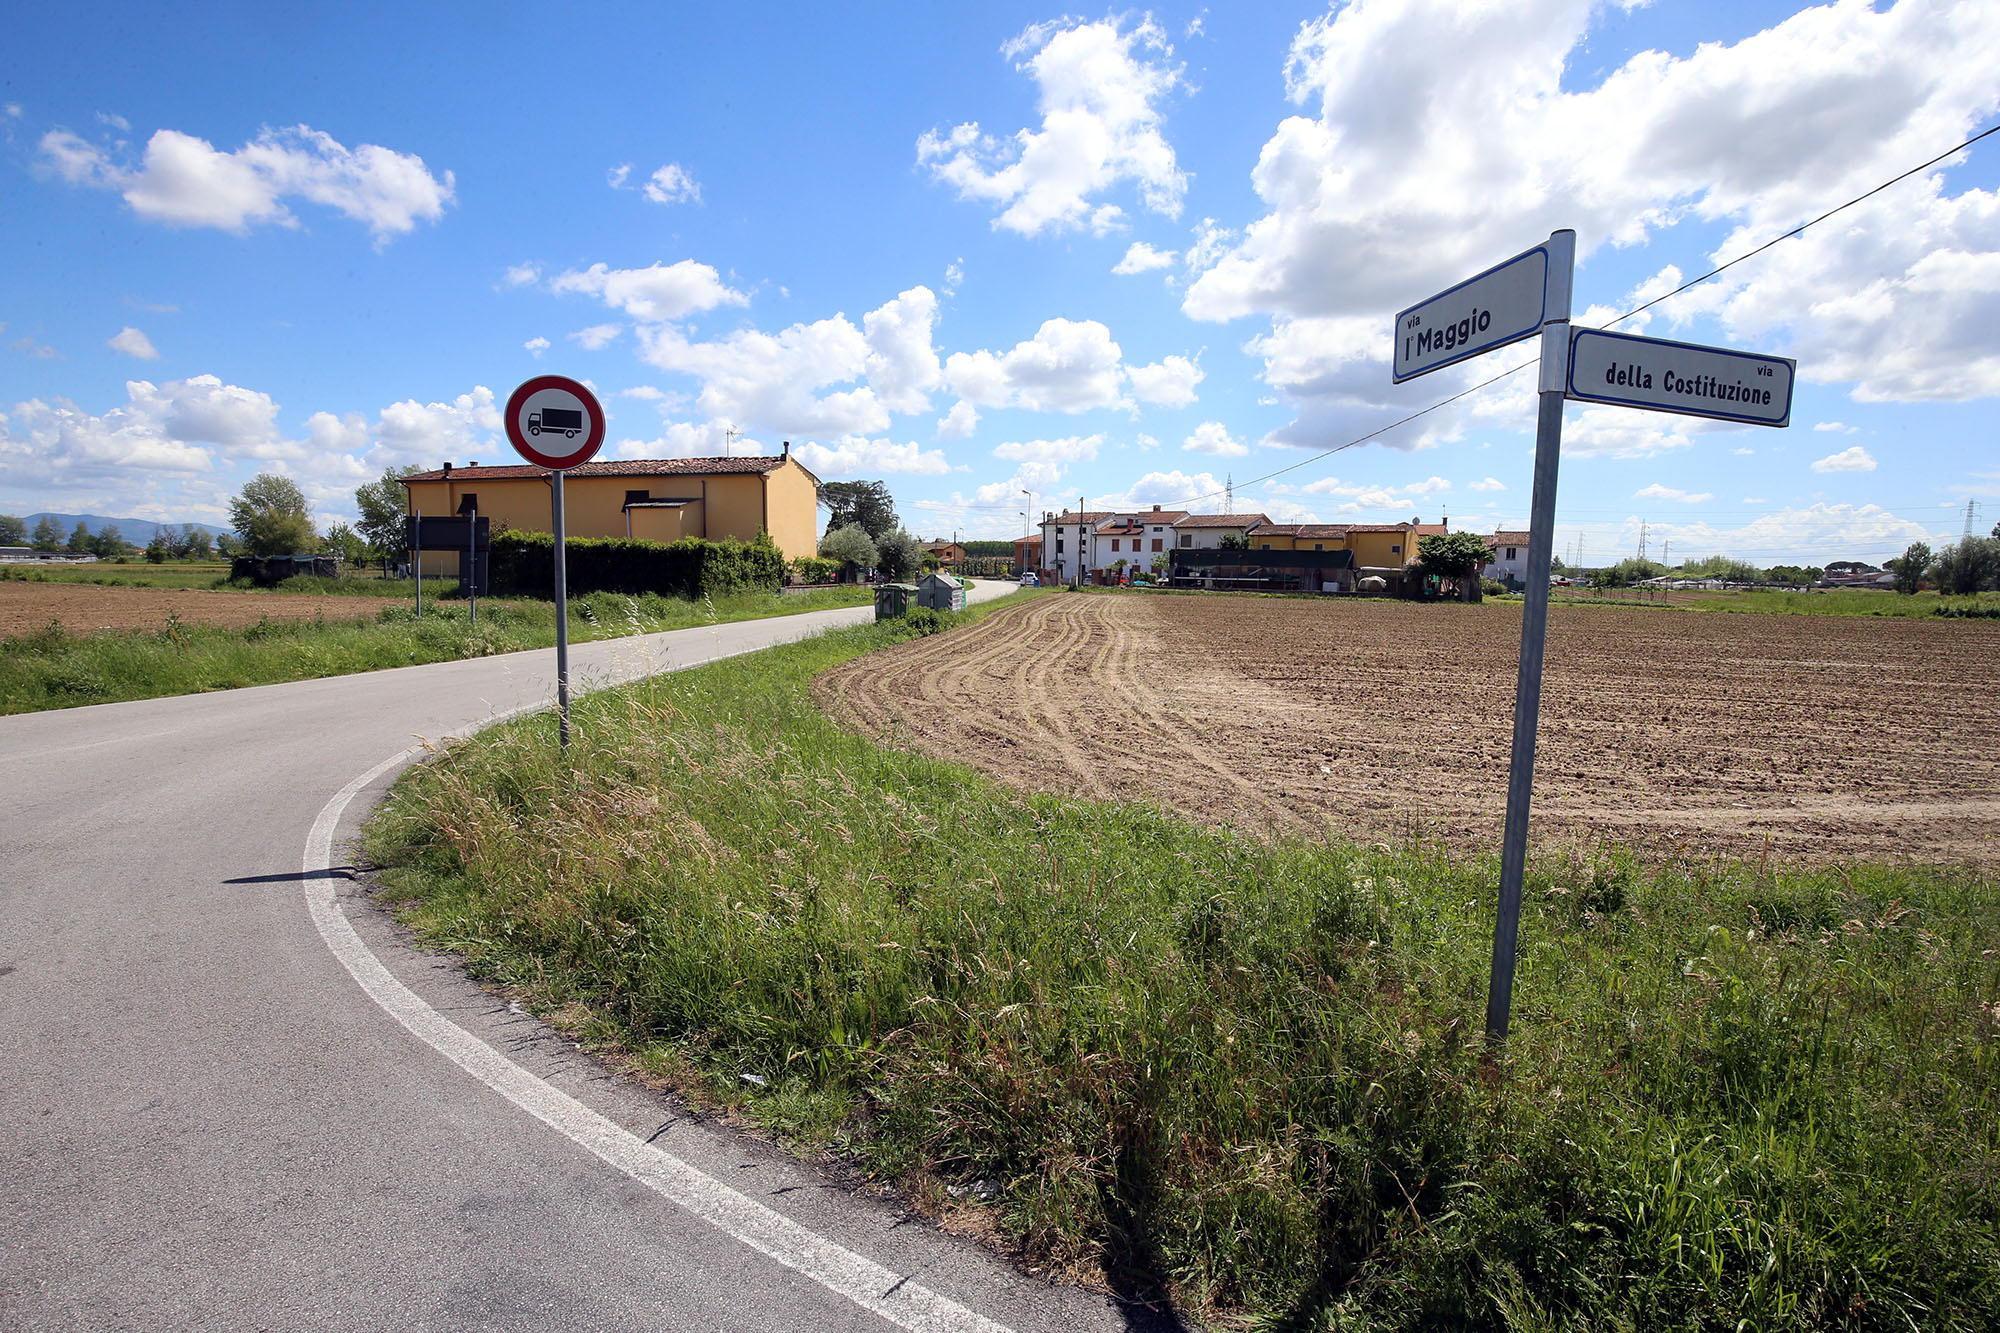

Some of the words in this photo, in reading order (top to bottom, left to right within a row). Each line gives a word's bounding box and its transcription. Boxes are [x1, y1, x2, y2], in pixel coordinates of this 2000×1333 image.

[1407, 315, 1420, 329] via
[1417, 308, 1491, 356] Maggio
[1605, 362, 1652, 389] della
[1663, 370, 1771, 405] Costituzione
[1757, 365, 1773, 377] via
